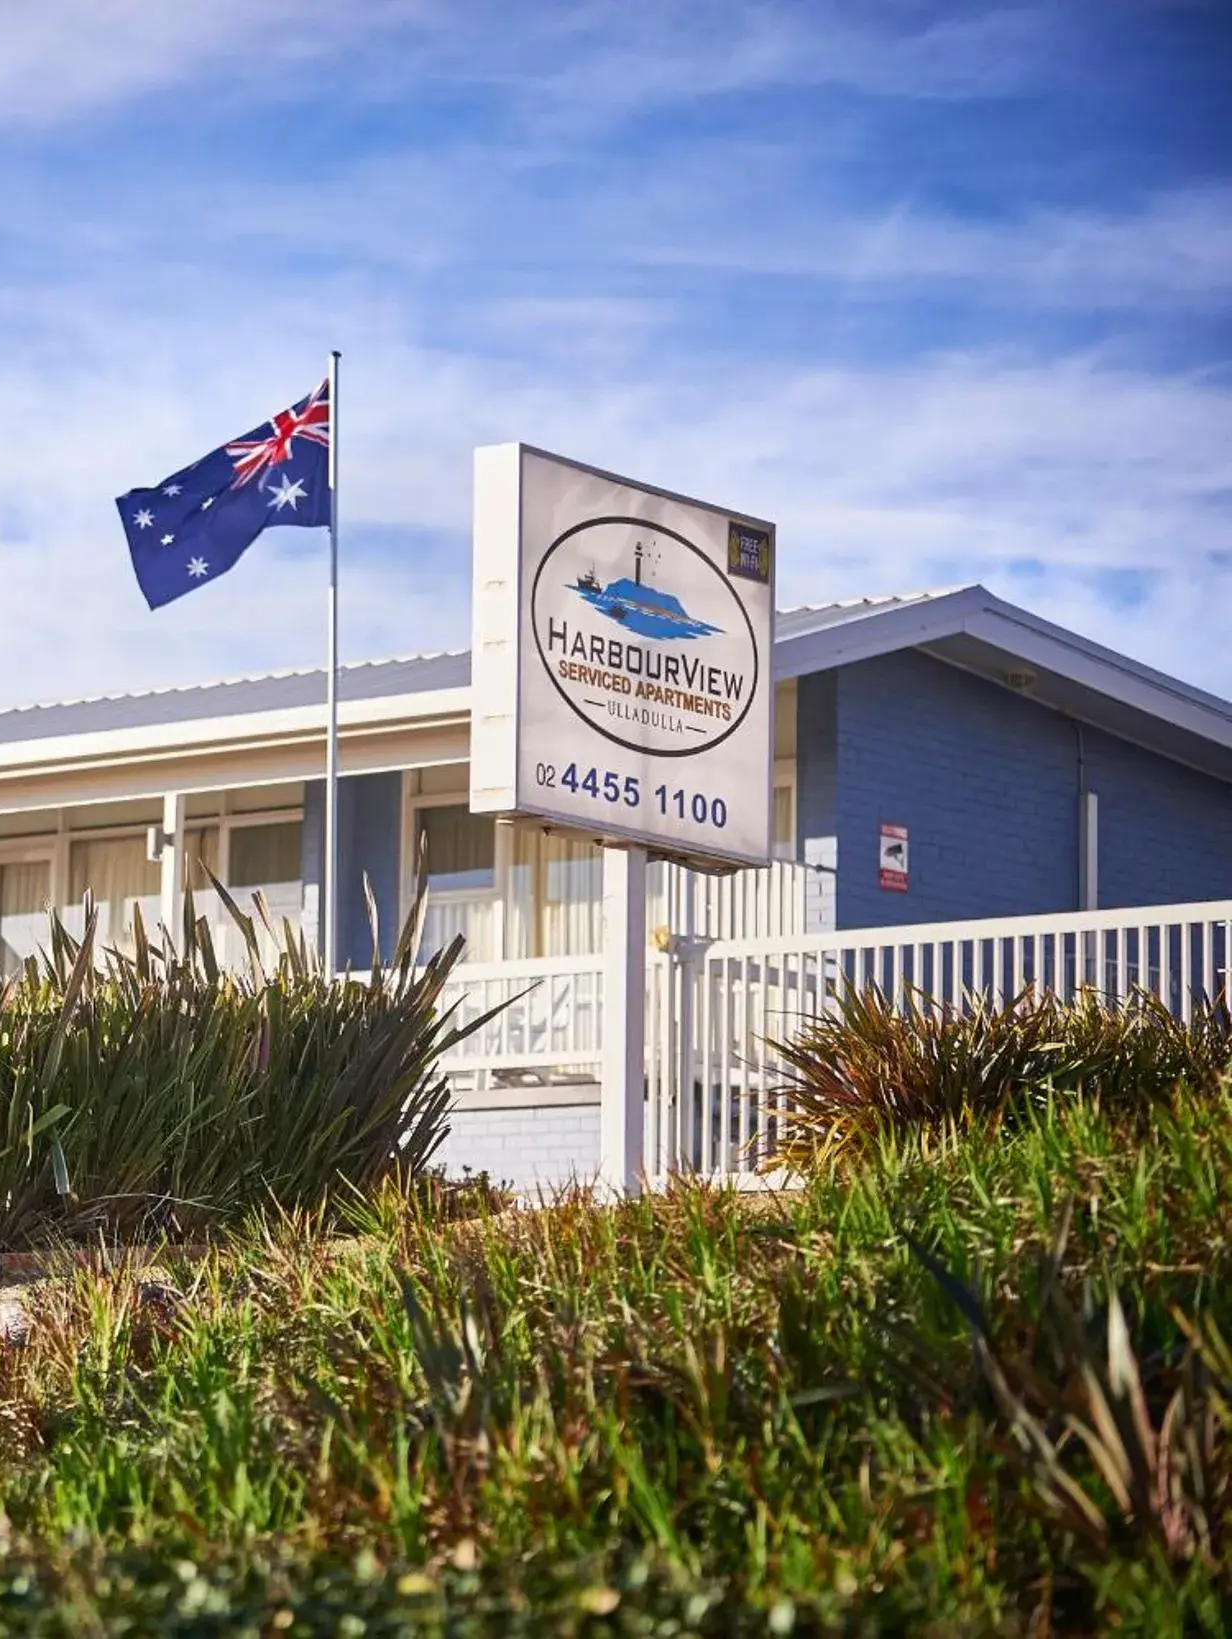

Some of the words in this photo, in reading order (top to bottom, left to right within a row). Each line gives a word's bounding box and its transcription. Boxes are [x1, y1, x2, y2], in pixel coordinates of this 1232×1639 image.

[558, 659, 632, 695] SERVICED
[635, 681, 732, 721] APARTMENTS
[607, 700, 684, 733] ULLADULLA
[536, 762, 556, 788] 02
[561, 762, 640, 807] 4455
[655, 784, 727, 828] 1100
